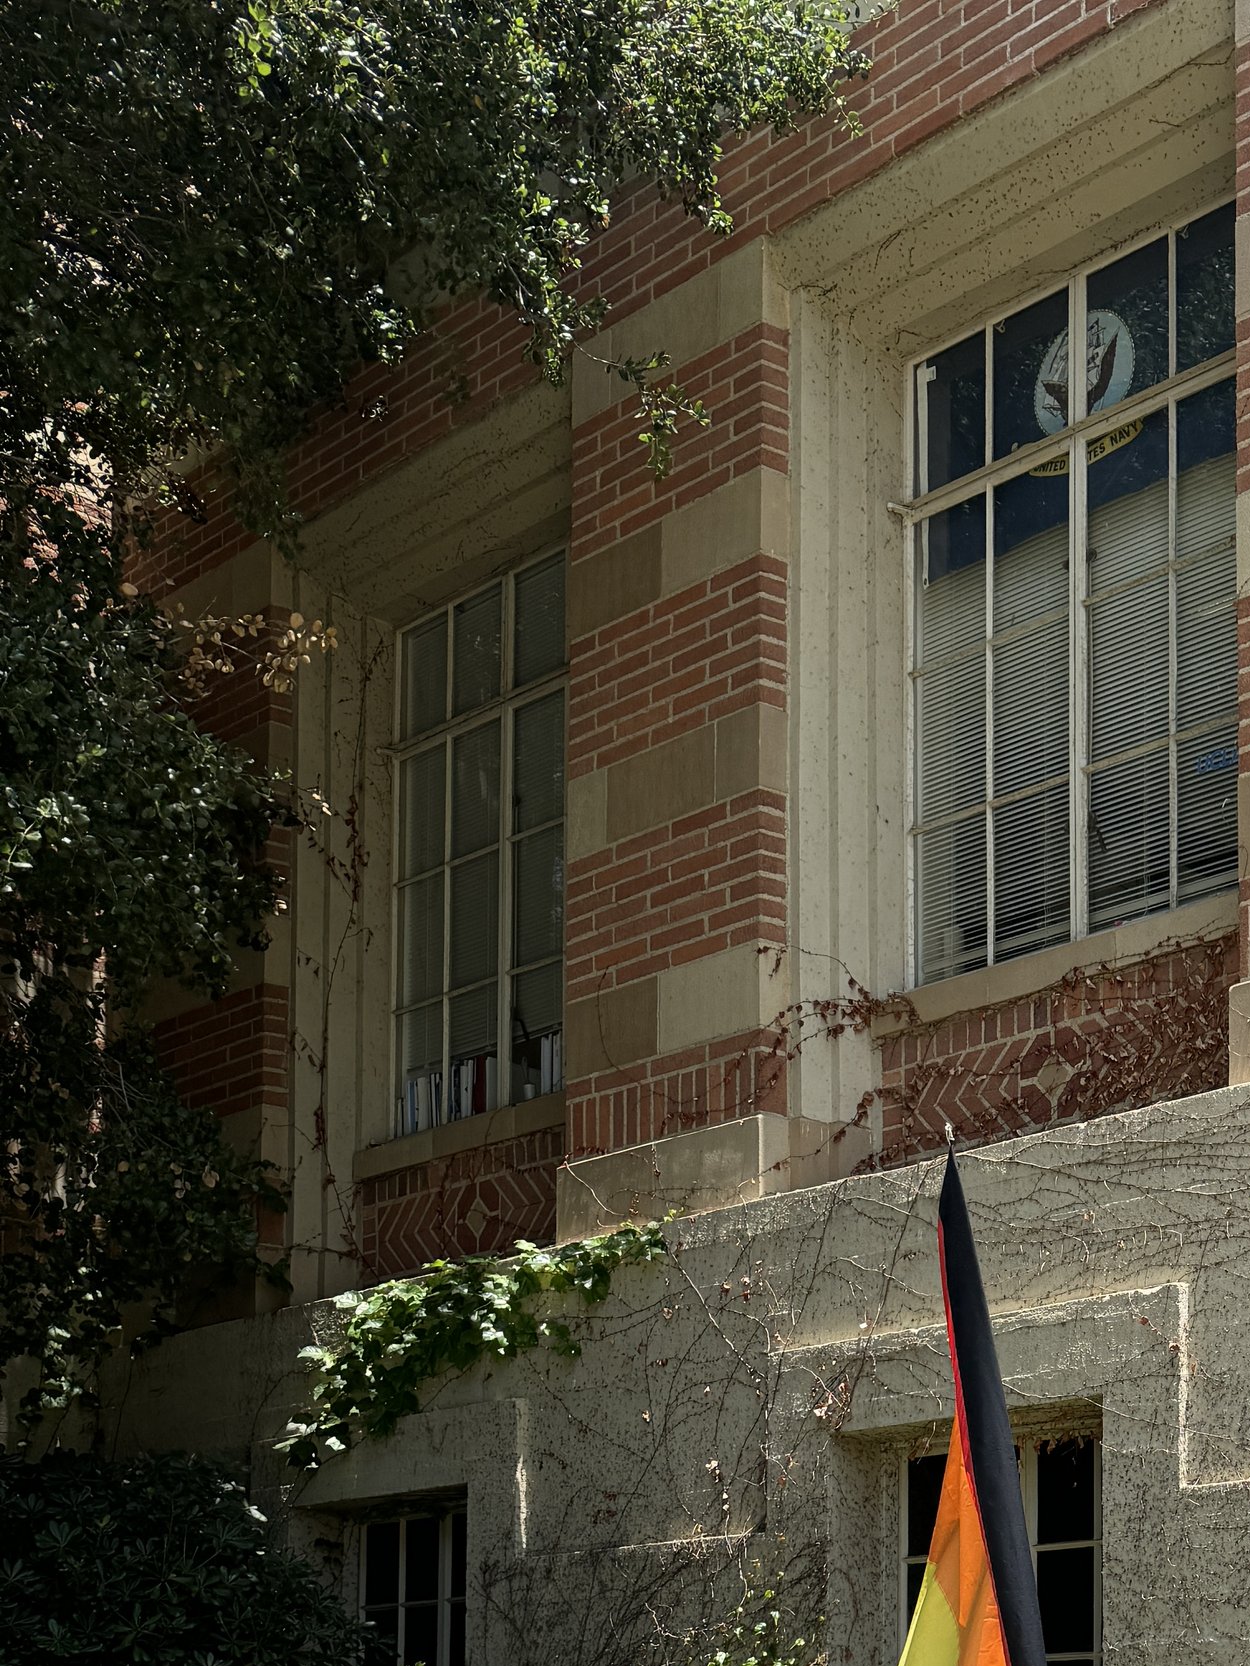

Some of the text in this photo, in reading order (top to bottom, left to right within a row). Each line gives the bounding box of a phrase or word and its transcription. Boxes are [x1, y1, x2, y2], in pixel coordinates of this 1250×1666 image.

[1033, 421, 1139, 473] UNITED TES NAVY
